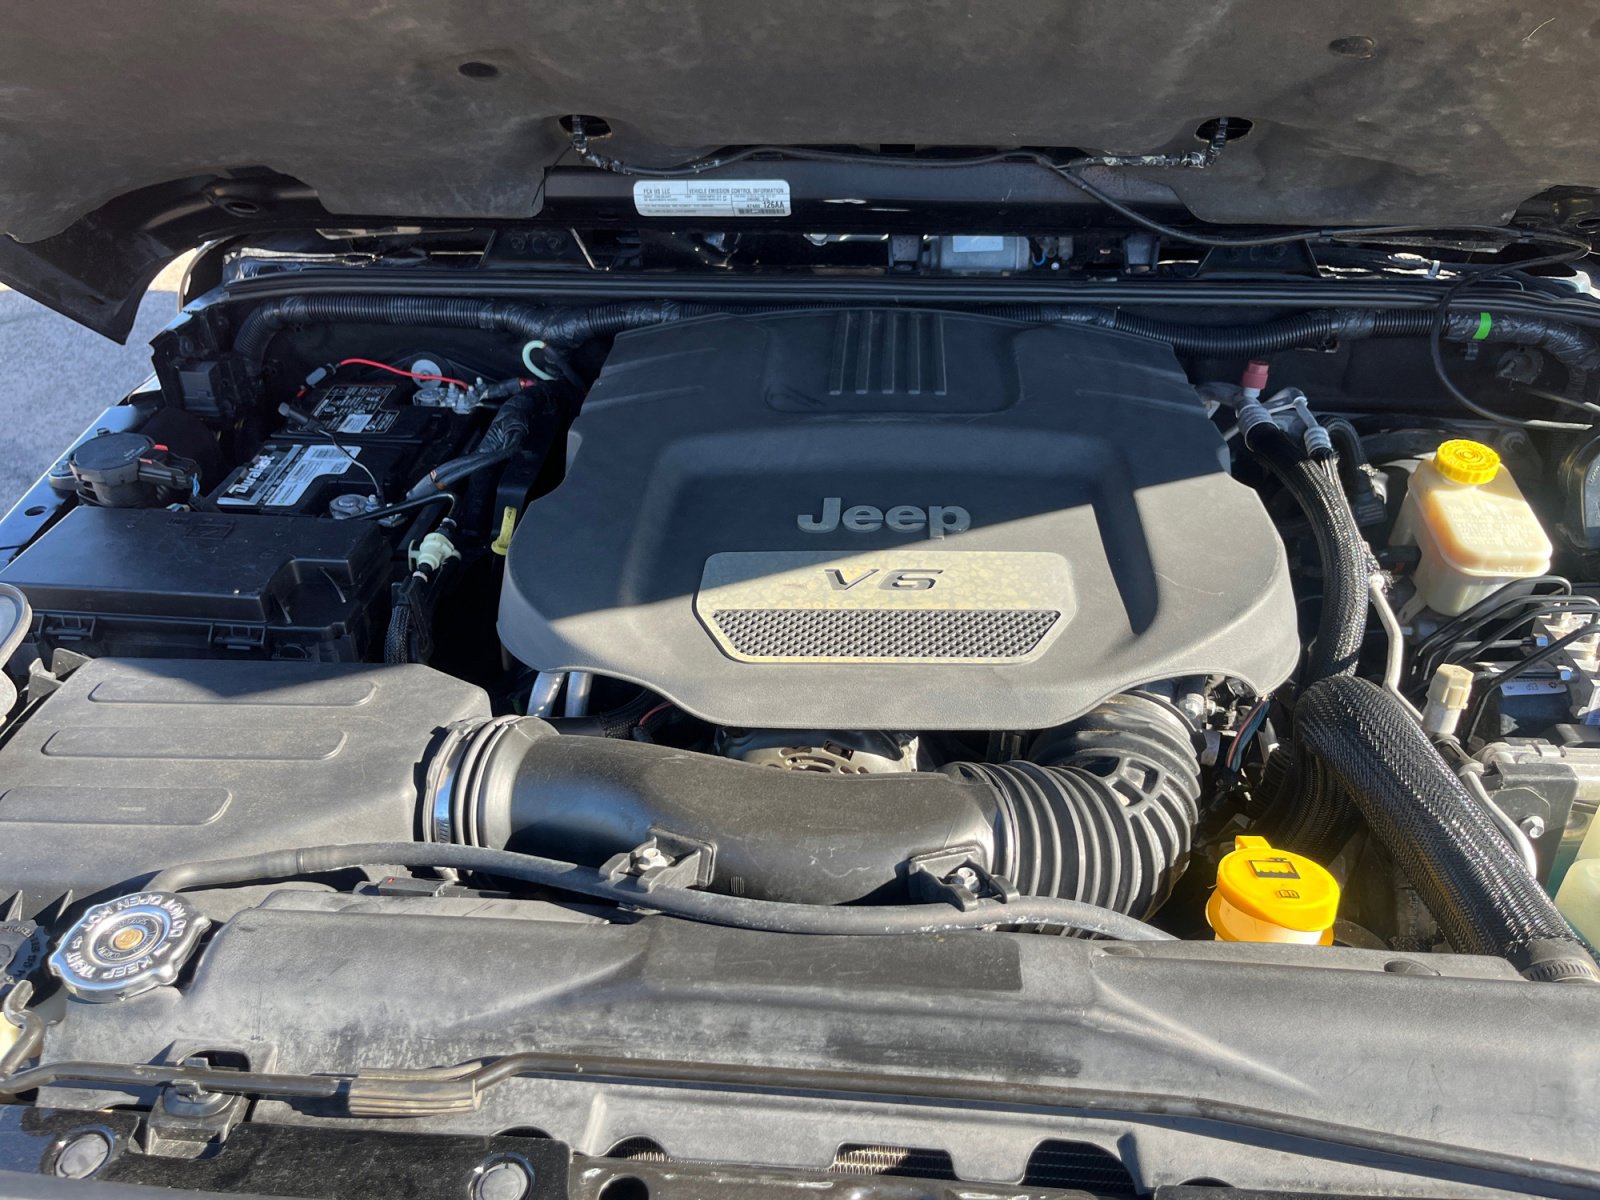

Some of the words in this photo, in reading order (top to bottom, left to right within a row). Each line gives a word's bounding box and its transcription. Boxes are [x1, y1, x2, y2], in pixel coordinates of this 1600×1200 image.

[763, 200, 785, 209] 126AA
[228, 455, 275, 494] Duralast
[797, 497, 971, 541] Jeep
[824, 568, 944, 590] V6
[117, 894, 163, 910] OPEN
[102, 955, 153, 979] KEEP
